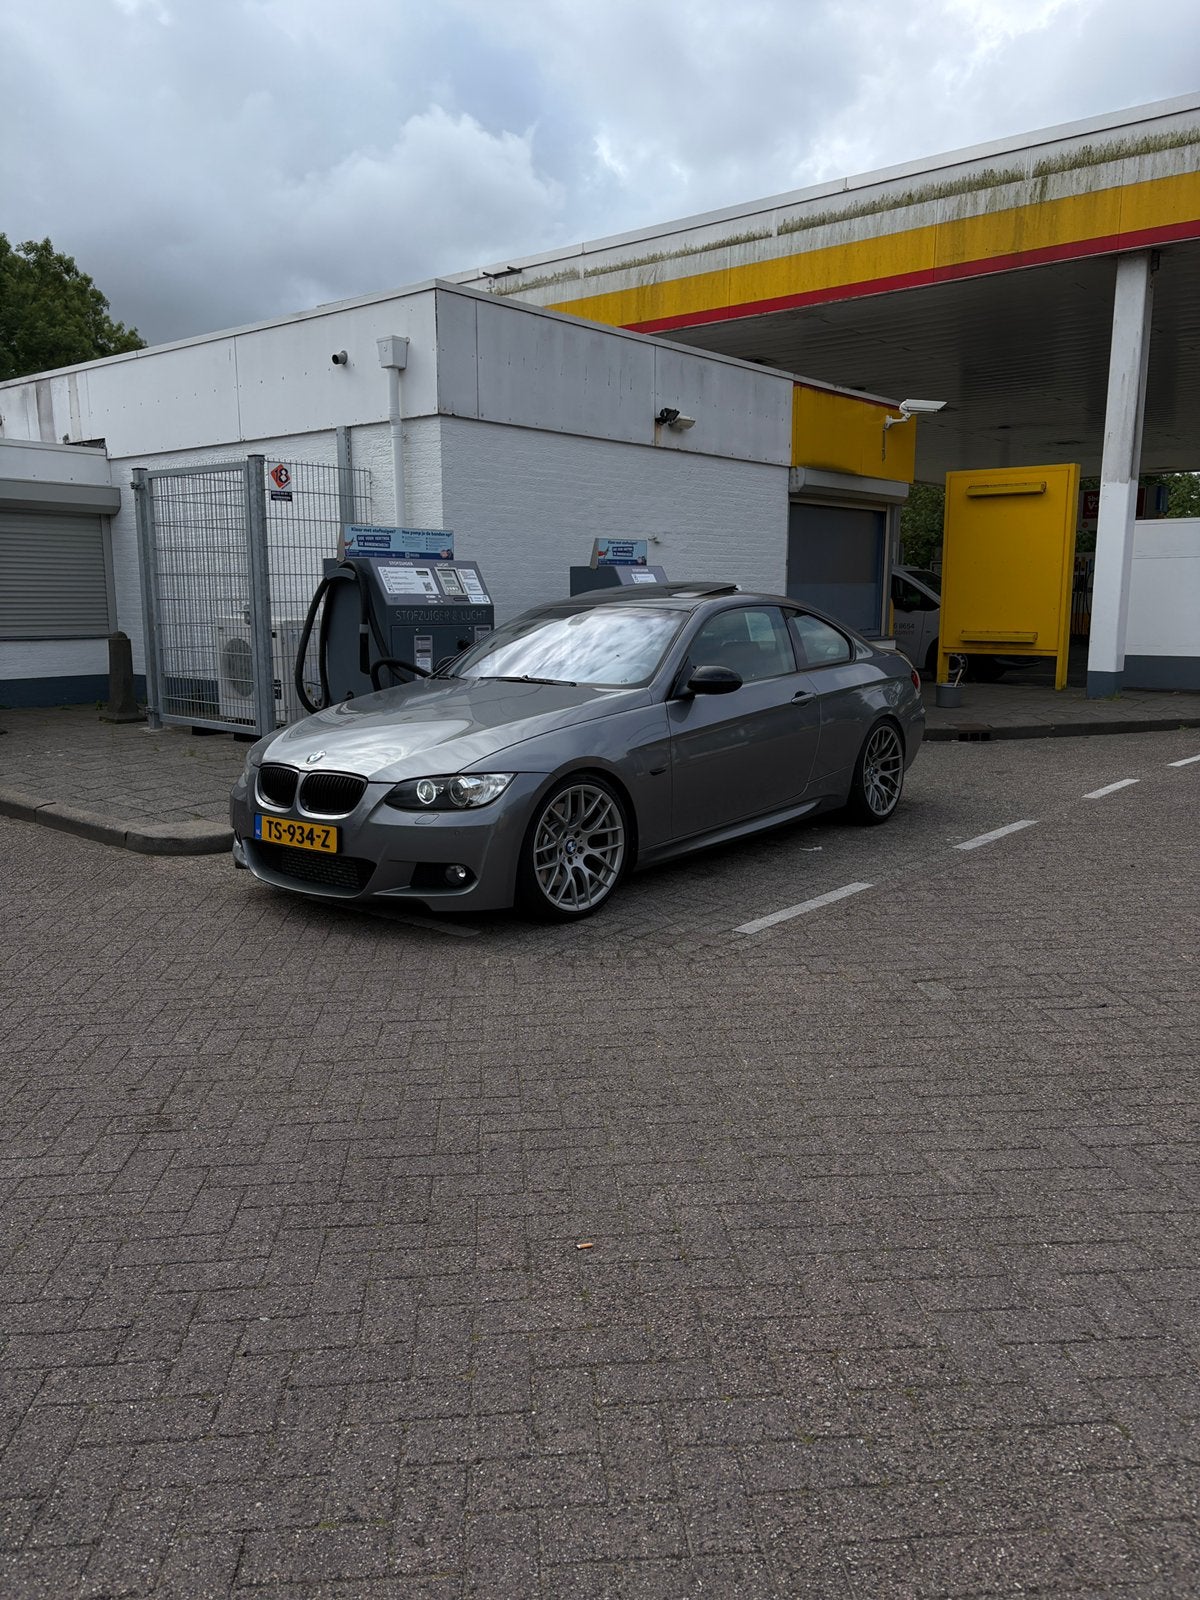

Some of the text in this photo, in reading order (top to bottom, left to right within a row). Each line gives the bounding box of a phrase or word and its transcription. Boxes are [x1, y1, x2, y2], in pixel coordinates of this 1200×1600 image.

[395, 610, 450, 621] STOFZUIGER
[461, 609, 487, 620] LUCHT
[266, 820, 331, 848] TS-934-Z
